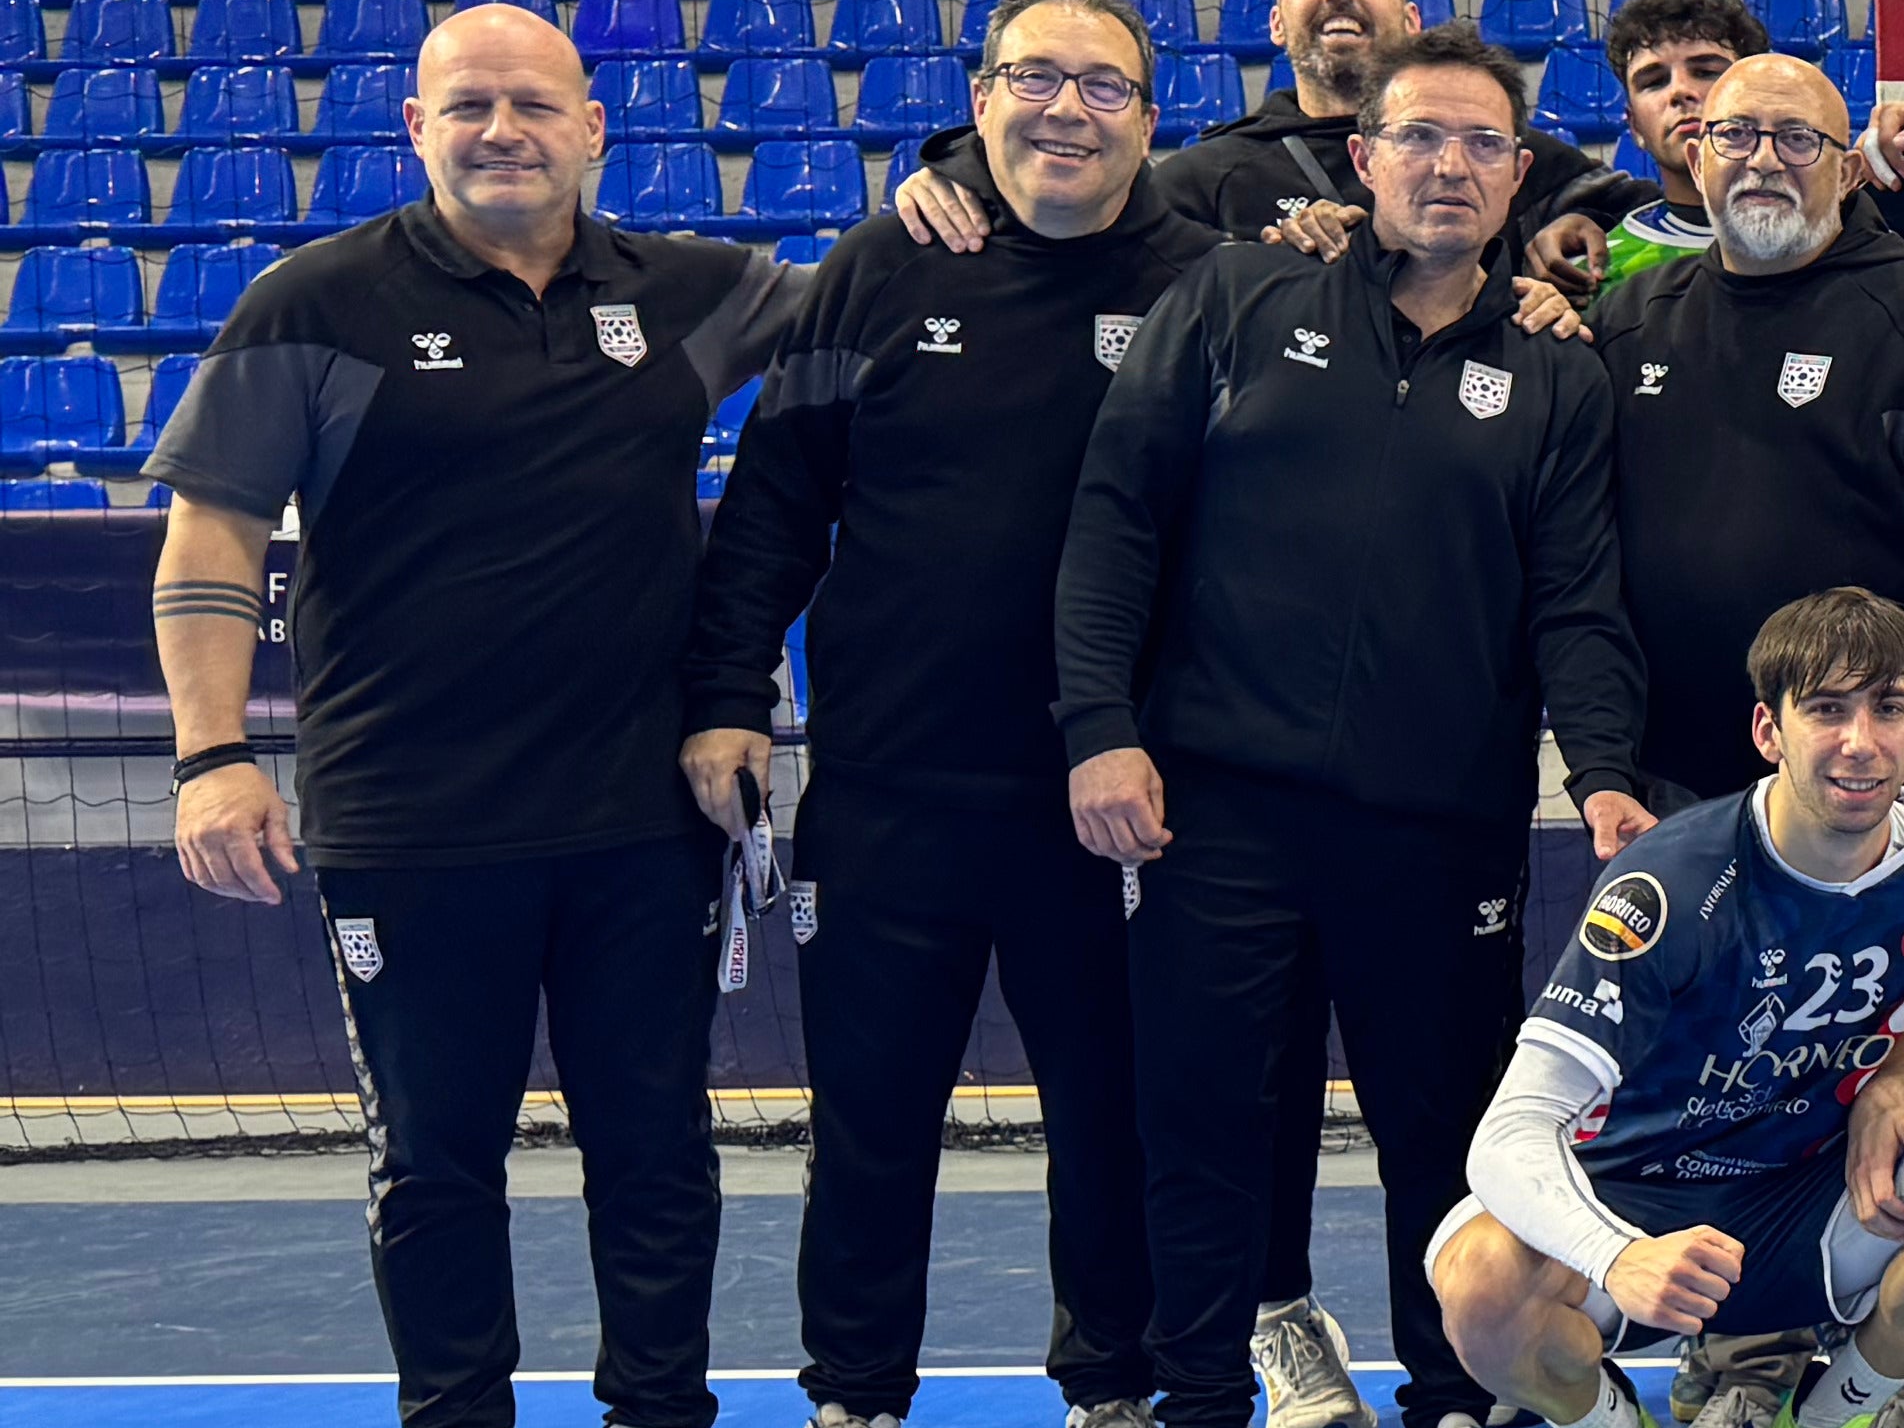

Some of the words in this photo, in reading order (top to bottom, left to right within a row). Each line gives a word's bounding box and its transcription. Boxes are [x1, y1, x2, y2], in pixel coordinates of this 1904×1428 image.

[1542, 982, 1599, 1017] uma
[1782, 944, 1890, 1032] 23
[1698, 1034, 1896, 1094] HORNEO
